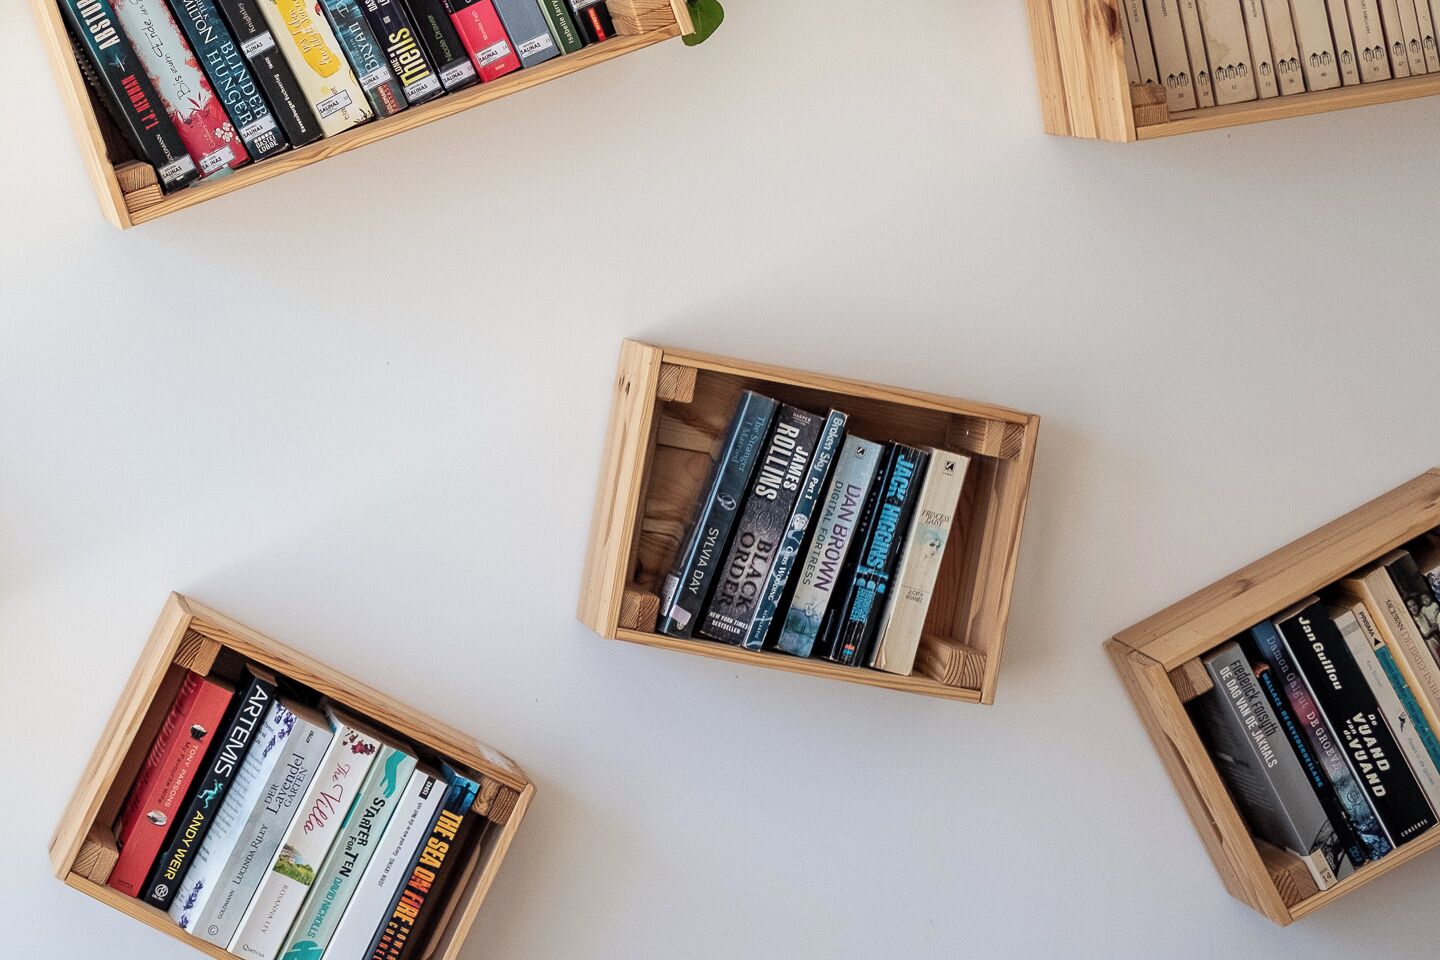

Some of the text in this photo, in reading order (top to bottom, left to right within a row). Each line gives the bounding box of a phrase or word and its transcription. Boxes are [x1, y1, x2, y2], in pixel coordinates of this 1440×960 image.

[346, 20, 379, 72] BRYAN
[389, 57, 403, 74] LONE
[426, 13, 453, 62] Nicole Drawer
[219, 40, 268, 117] BLINDER
[736, 414, 765, 472] The Stranger
[754, 421, 799, 501] ROLLINS
[782, 445, 809, 491] JAMES
[801, 479, 843, 586] DIGITAL FORTRESS
[813, 482, 862, 593] DAN BROWN
[865, 453, 915, 569] JACK HIGGINS
[686, 526, 719, 594] SYLVIA DAY
[717, 529, 757, 608] ORDER
[734, 538, 772, 612] BLACK
[1229, 657, 1261, 701] Frederick
[1297, 613, 1344, 691] Jan Guillou
[213, 684, 270, 779] ARTEMIS
[1218, 666, 1278, 768] DE DAG VAN DE JAKHALS
[1305, 710, 1342, 771] DE GROEVE
[1345, 718, 1357, 735] van
[162, 743, 198, 808] TONY PARSONS
[263, 782, 279, 805] DER
[264, 752, 306, 815] Lavendel
[281, 766, 308, 808] GARTEN
[298, 760, 351, 841] The Villa
[163, 810, 206, 881] ANDY WEIR
[352, 795, 386, 847] STARTER
[231, 823, 269, 886] LUCINDA RILEY
[336, 848, 358, 879] TEN
[392, 806, 463, 927] THE SEA ON FIRE
[259, 883, 289, 934] ROSANNA LEY
[305, 876, 343, 939] DAVID NICHOLLS
